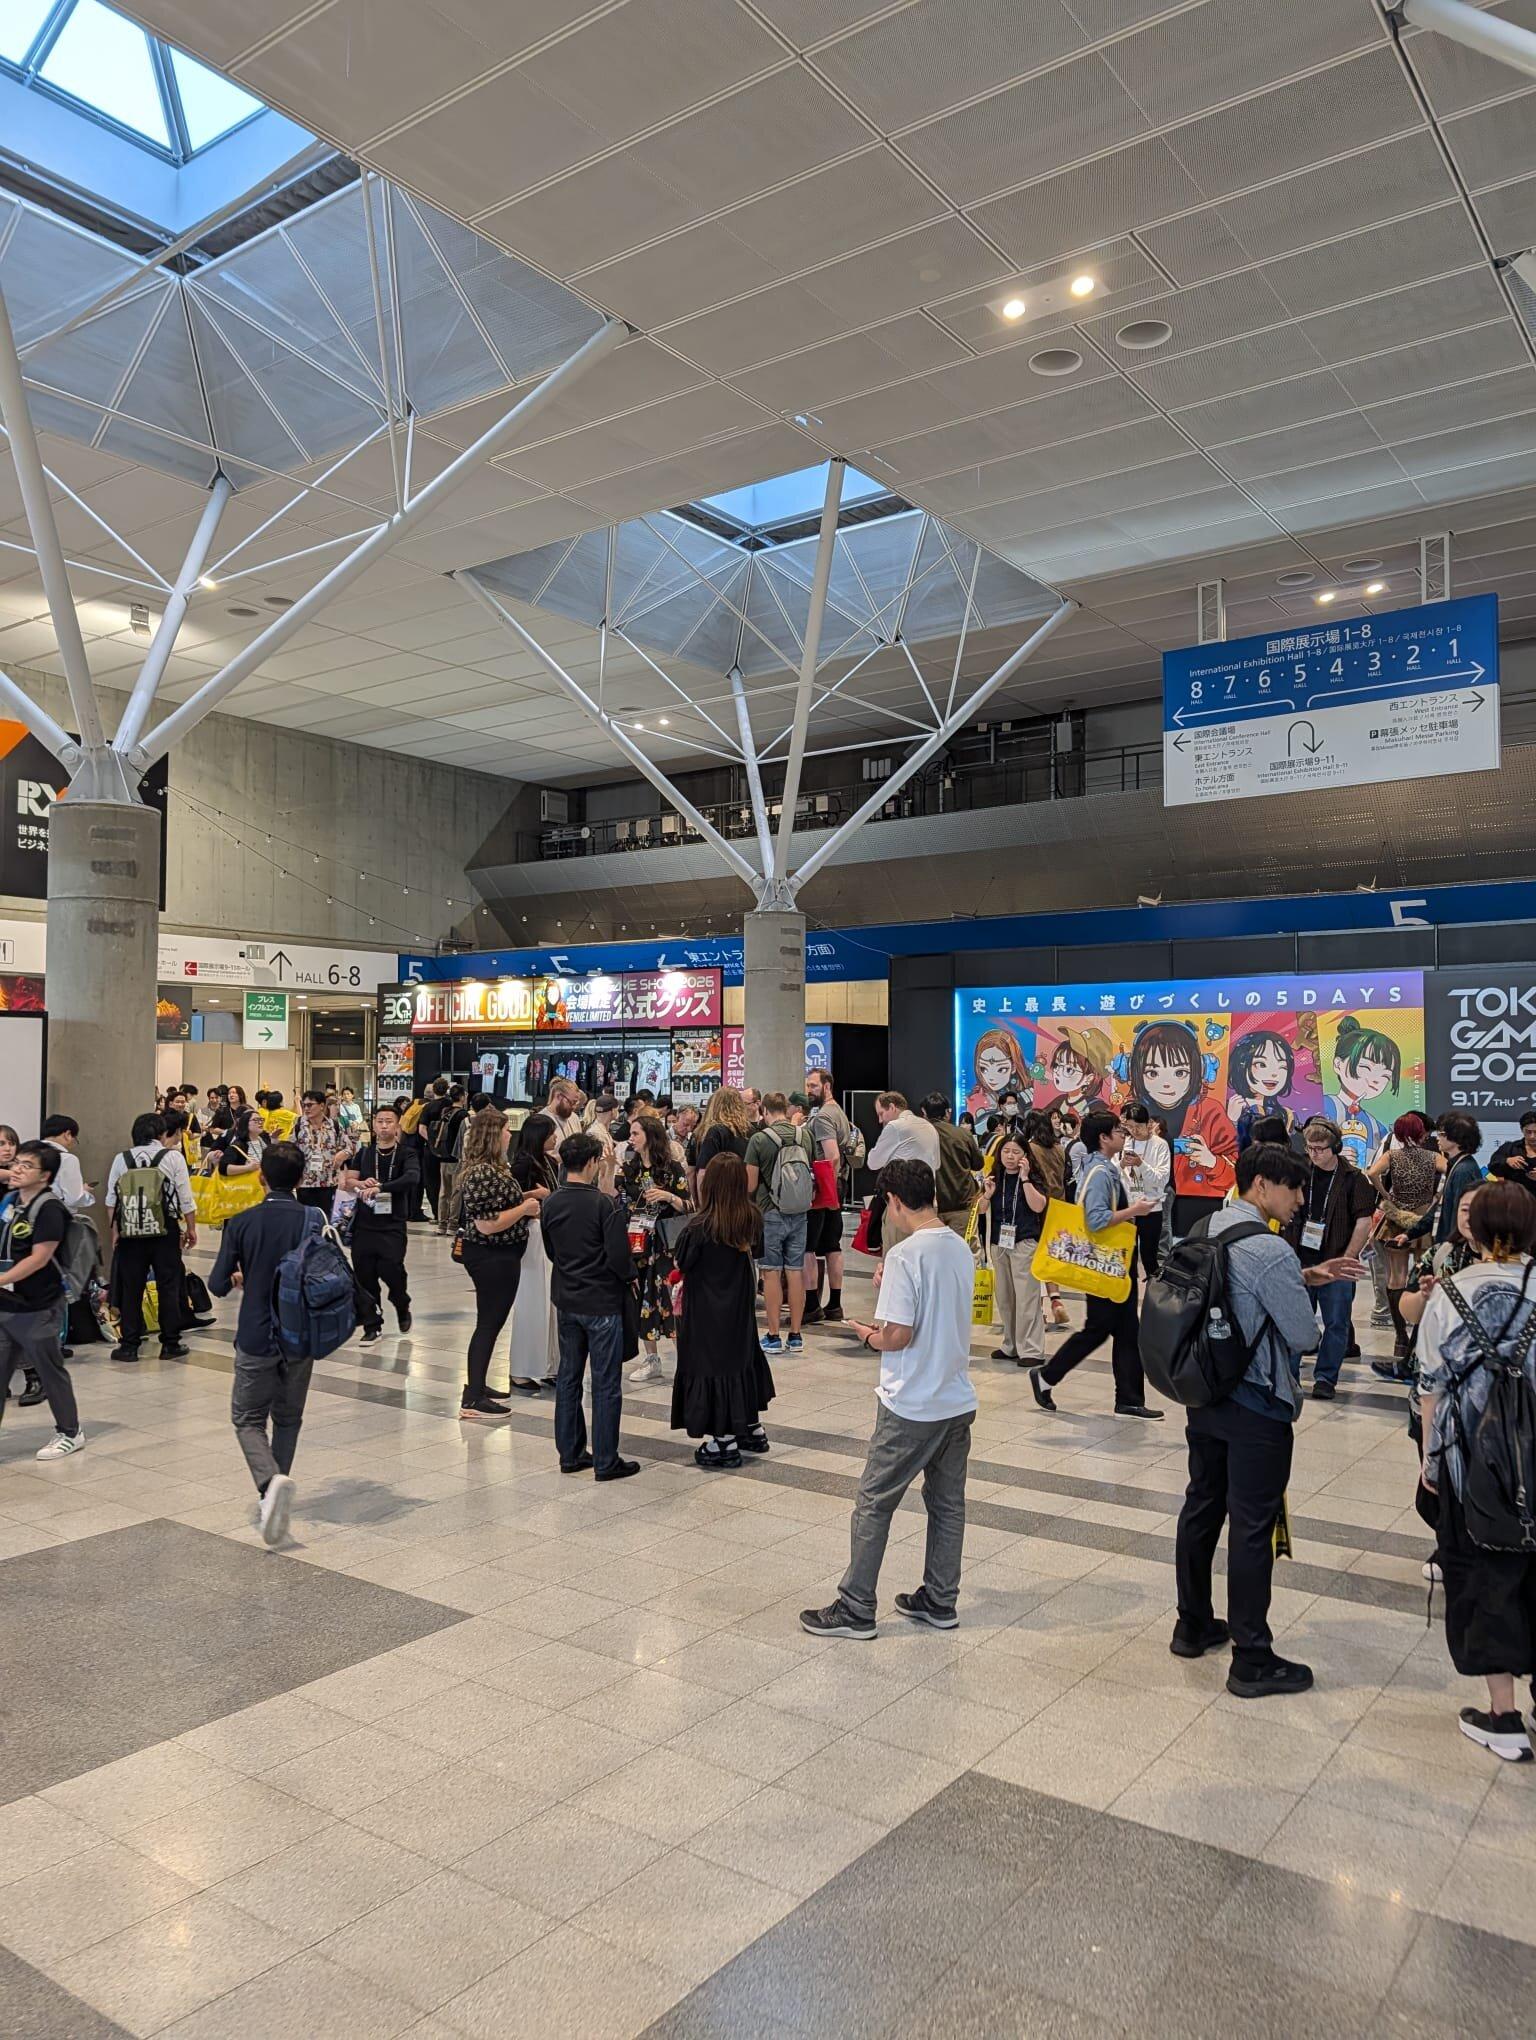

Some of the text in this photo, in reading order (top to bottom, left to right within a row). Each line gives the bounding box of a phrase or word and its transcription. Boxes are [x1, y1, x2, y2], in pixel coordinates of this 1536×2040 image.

[1190, 661, 1241, 678] International
[1243, 656, 1285, 669] Exhibition
[1287, 651, 1304, 661] Hall
[1446, 624, 1462, 634] 1-8
[1190, 638, 1458, 699] 8 7 6 5 4 3 2 1
[1389, 693, 1458, 712] 西エントランス
[1194, 747, 1253, 763] 東エントランス
[1195, 773, 1236, 786] ホテル方面
[17, 824, 49, 838] 世界を
[17, 838, 49, 852] ビジネ
[296, 964, 361, 986] HALL 6-8
[416, 989, 485, 1023] OFFICIAL
[125, 1221, 161, 1236] THER
